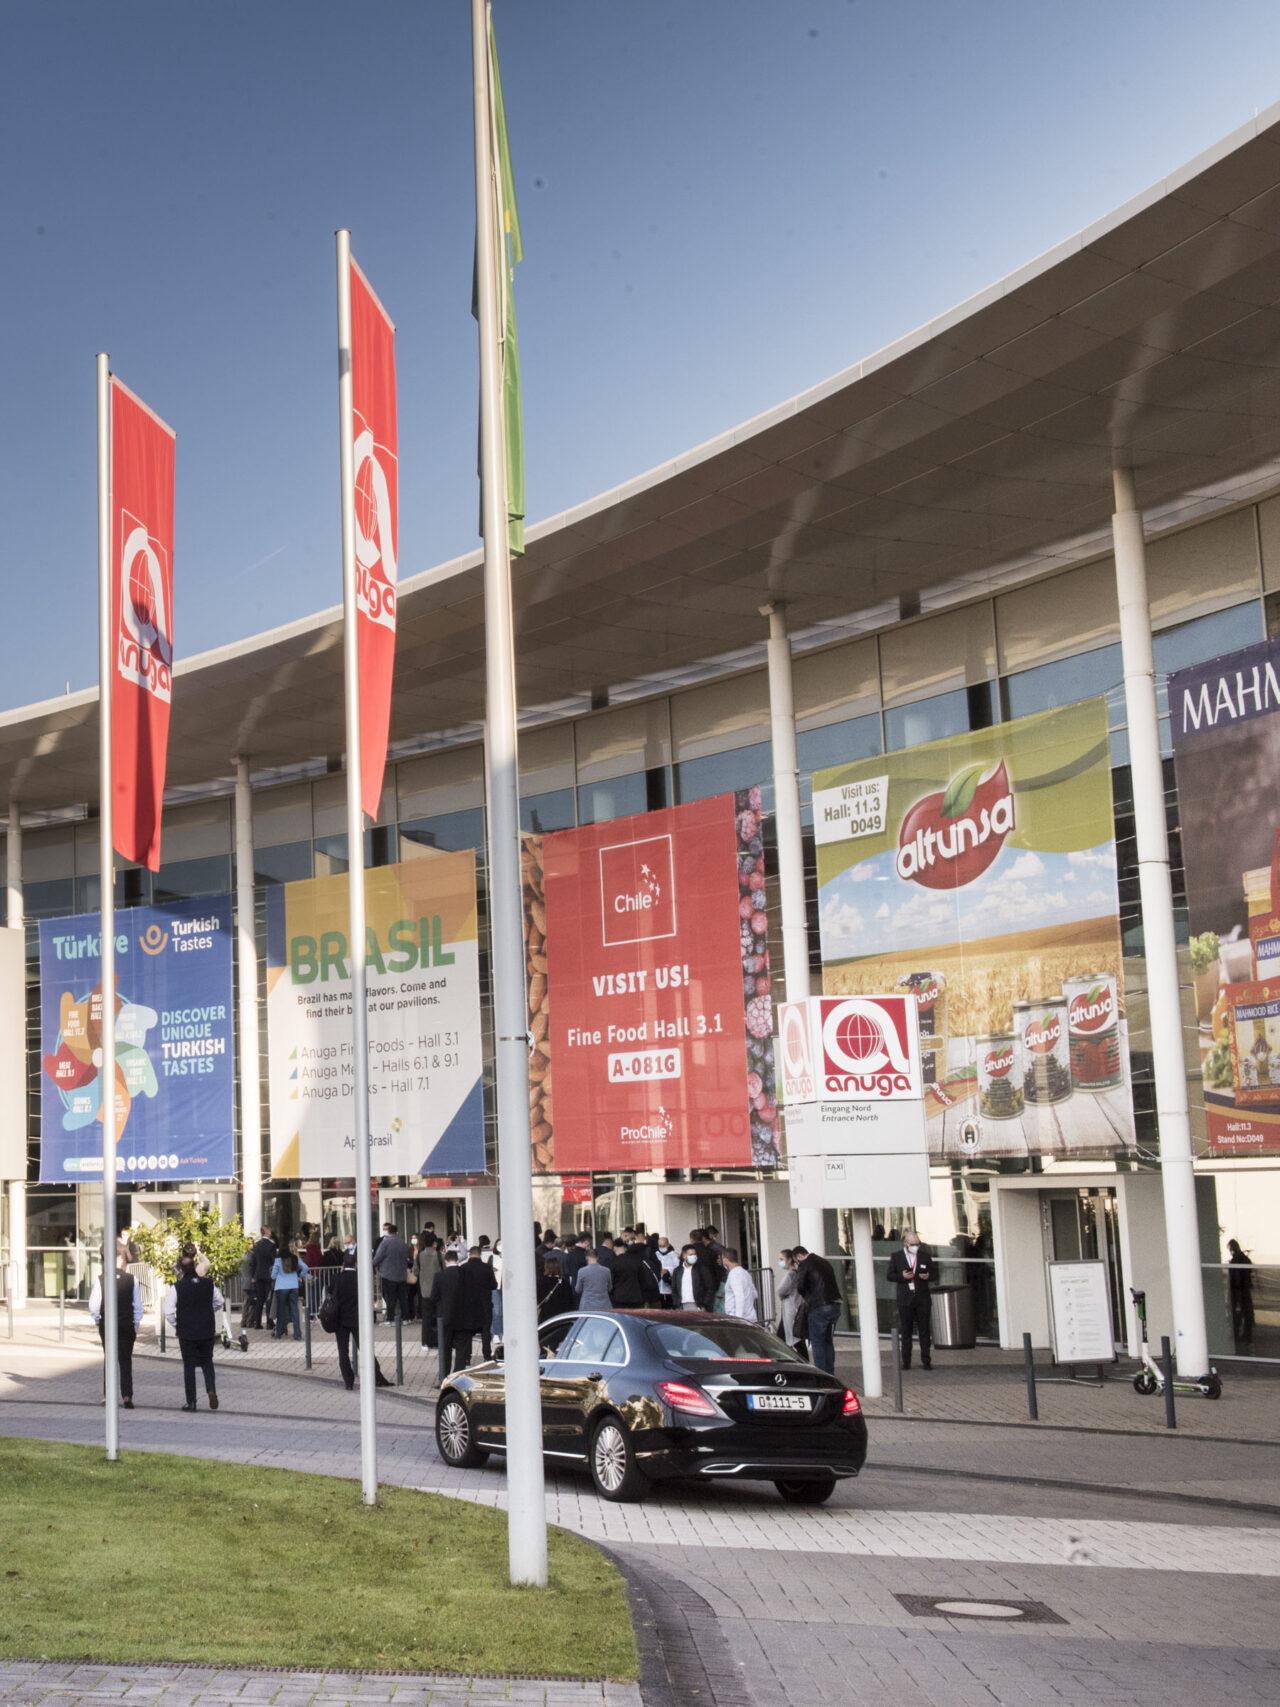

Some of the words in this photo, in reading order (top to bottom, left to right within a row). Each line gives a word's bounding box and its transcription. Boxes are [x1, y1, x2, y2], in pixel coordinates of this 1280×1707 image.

[841, 784, 863, 801] Visit
[865, 783, 880, 795] us:
[824, 804, 851, 823] Hall:
[855, 796, 881, 816] 11.3
[851, 815, 882, 834] D049
[897, 793, 1015, 880] altunsa
[614, 890, 653, 914] Chile
[171, 915, 220, 937] Turkish
[172, 936, 213, 953] Tastes
[298, 993, 321, 1005] Brazil
[323, 990, 338, 1002] has
[400, 981, 426, 993] Come
[429, 977, 447, 989] and
[592, 970, 647, 996] VISIT
[655, 964, 689, 988] US!
[161, 1005, 226, 1026] DISCOVER
[306, 1008, 323, 1018] find
[325, 1005, 345, 1017] their
[368, 1002, 377, 1012] at
[379, 1002, 394, 1011] our
[397, 996, 441, 1010] pavilions.
[1070, 996, 1113, 1026] altunsa
[161, 1023, 212, 1041] UNIQUE
[568, 1027, 601, 1047] Fine
[607, 1021, 647, 1043] Food
[654, 1017, 690, 1039] Hall
[696, 1013, 723, 1034] 3.1
[1025, 1024, 1061, 1049] altunsa
[161, 1038, 225, 1059] TURKISH
[302, 1046, 337, 1060] Anuga
[369, 1038, 404, 1053] Foods
[418, 1034, 441, 1048] Hall
[445, 1032, 459, 1045] 3.1
[162, 1057, 214, 1077] TASTES
[302, 1066, 338, 1080] Anuga
[382, 1056, 410, 1072] Halls
[414, 1056, 428, 1069] 6.1
[432, 1056, 441, 1068] &
[444, 1053, 459, 1066] 9.1
[613, 1055, 676, 1077] A-081G
[302, 1087, 338, 1100] Anuga
[391, 1079, 413, 1092] Hall
[417, 1077, 430, 1090] 7.1
[825, 1075, 912, 1096] anuga
[821, 1105, 851, 1113] Eingang
[852, 1104, 872, 1112] Nord
[822, 1114, 855, 1122] Entrance
[856, 1113, 879, 1121] North
[621, 1125, 667, 1140] ProChile
[1218, 1135, 1236, 1144] Stand
